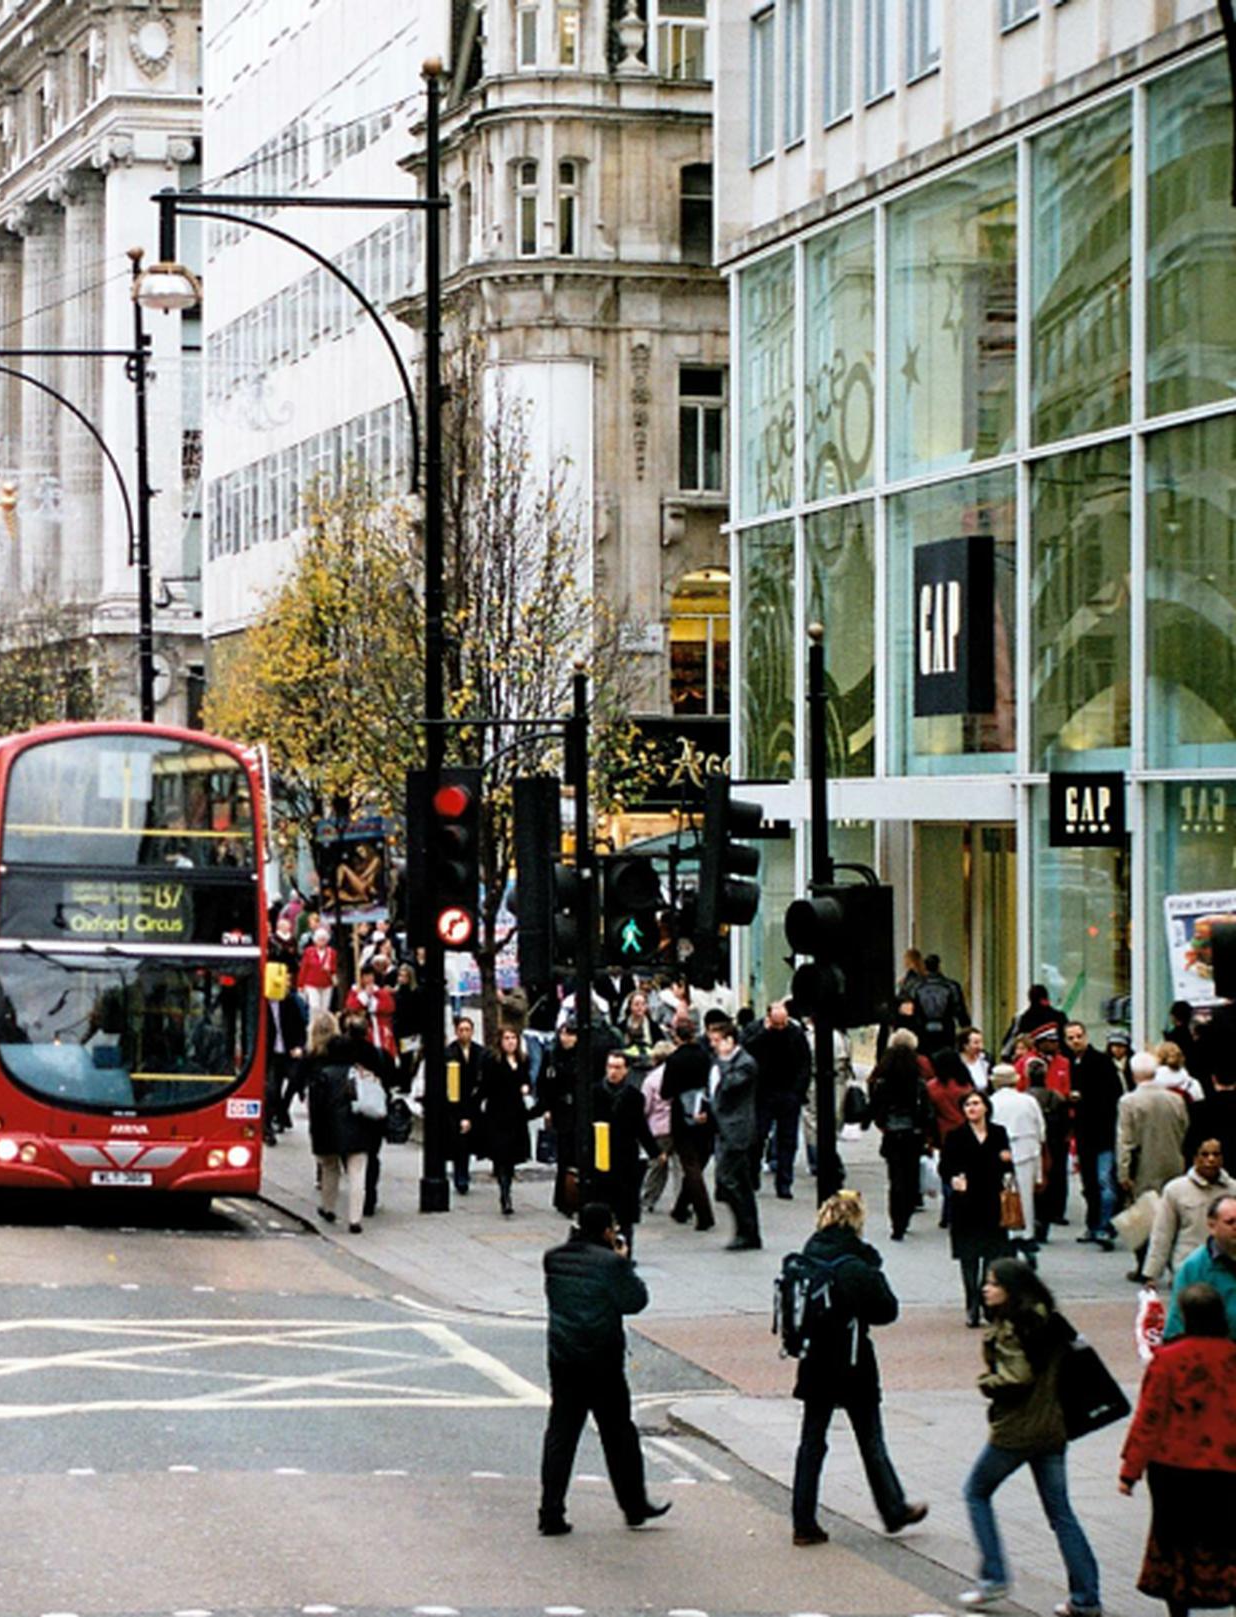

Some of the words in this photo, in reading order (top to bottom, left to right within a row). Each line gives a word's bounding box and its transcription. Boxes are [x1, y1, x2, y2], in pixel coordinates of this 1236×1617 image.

[920, 580, 960, 675] GAP
[1065, 786, 1111, 821] GAP
[70, 914, 129, 932] Oxford
[133, 914, 184, 932] Circus
